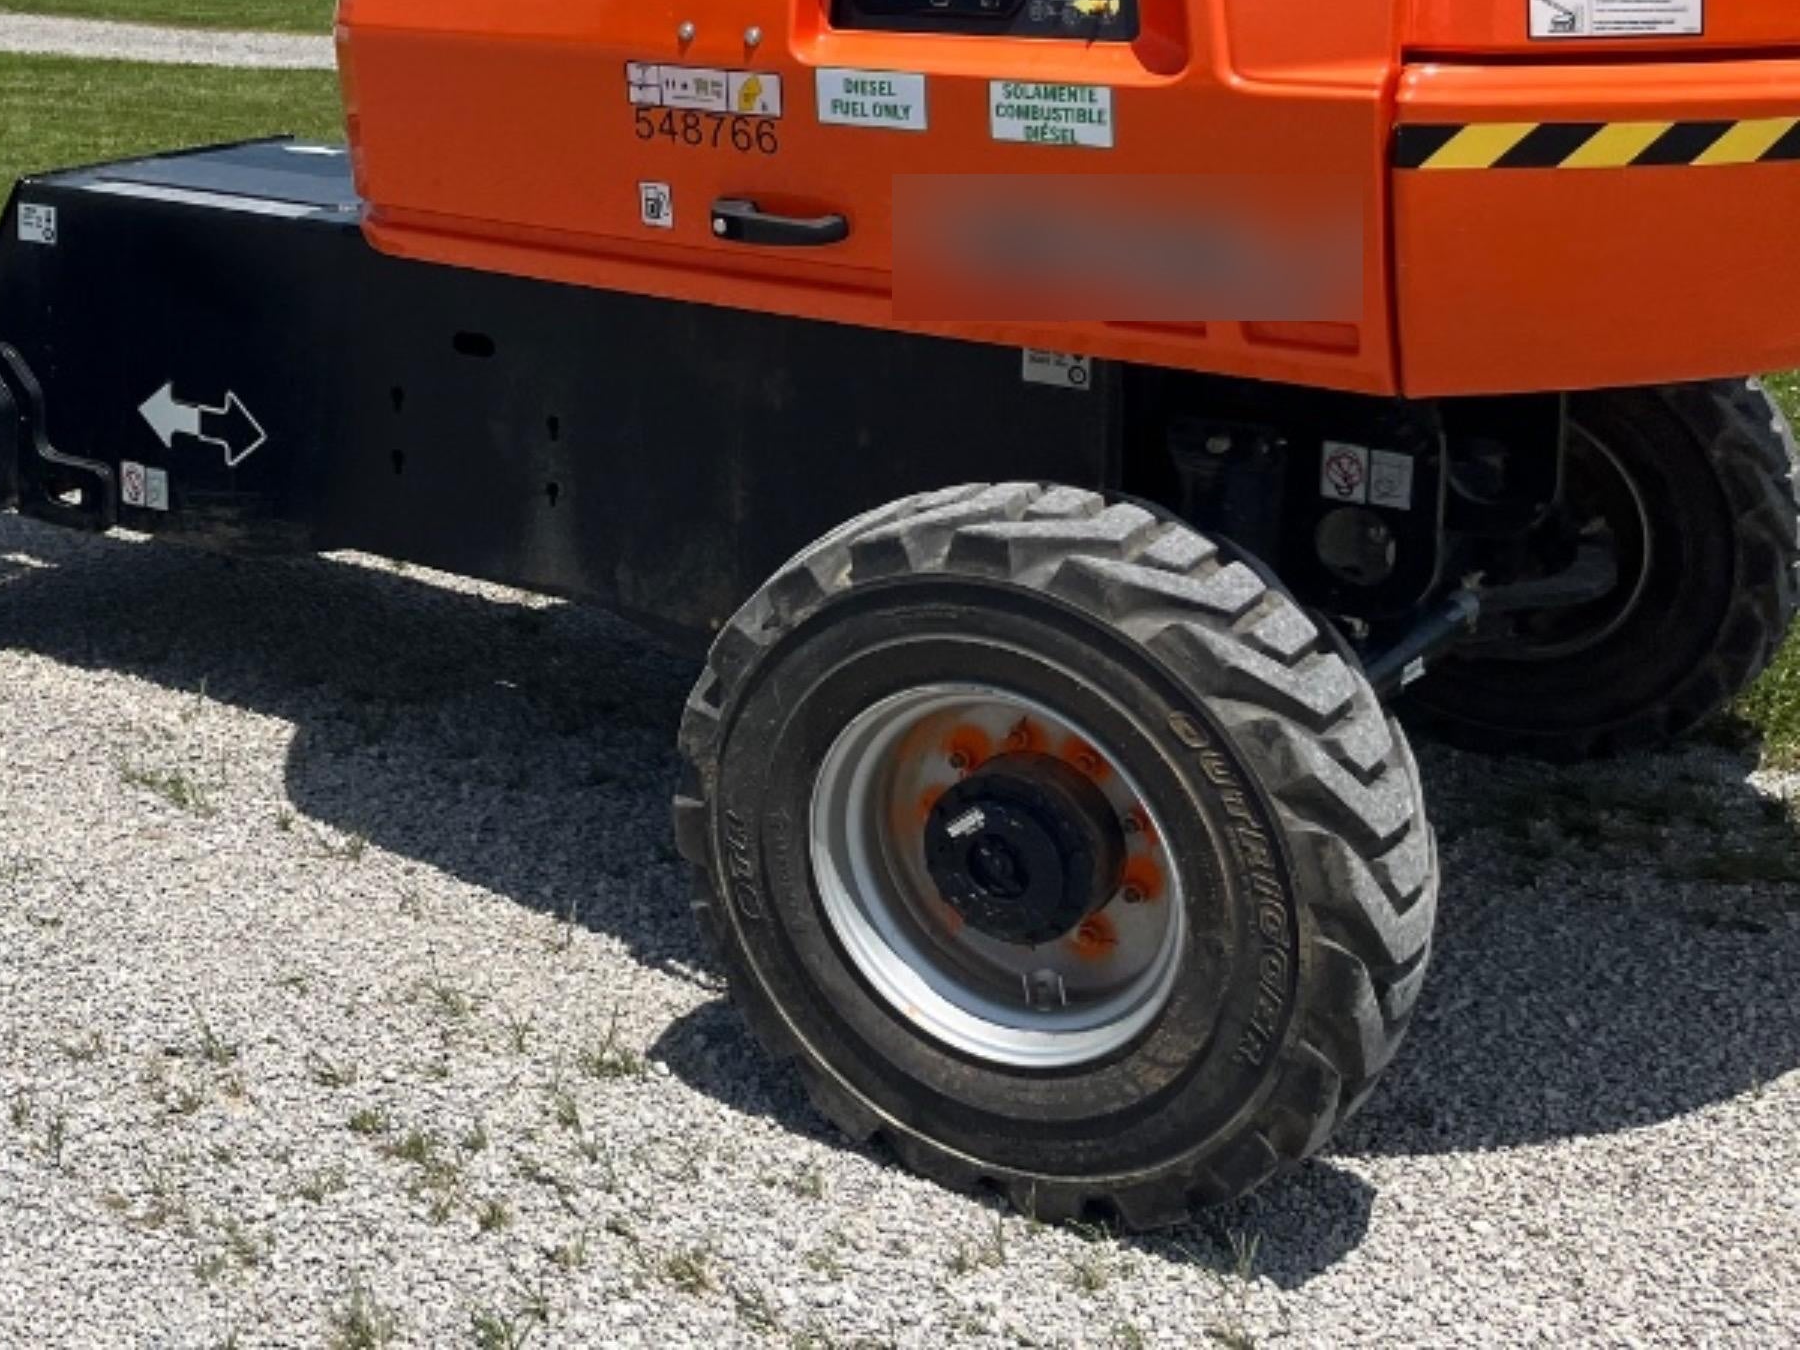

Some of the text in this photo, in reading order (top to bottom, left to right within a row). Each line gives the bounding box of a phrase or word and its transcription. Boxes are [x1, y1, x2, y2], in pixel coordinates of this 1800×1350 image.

[843, 77, 897, 97] DIESEL
[1002, 83, 1098, 103] SOLAMENTE
[831, 98, 912, 121] FUEL ONLY
[996, 103, 1107, 125] COMBUSTIBLE
[635, 107, 778, 154] 548766
[1023, 122, 1077, 145] DIÉSEL
